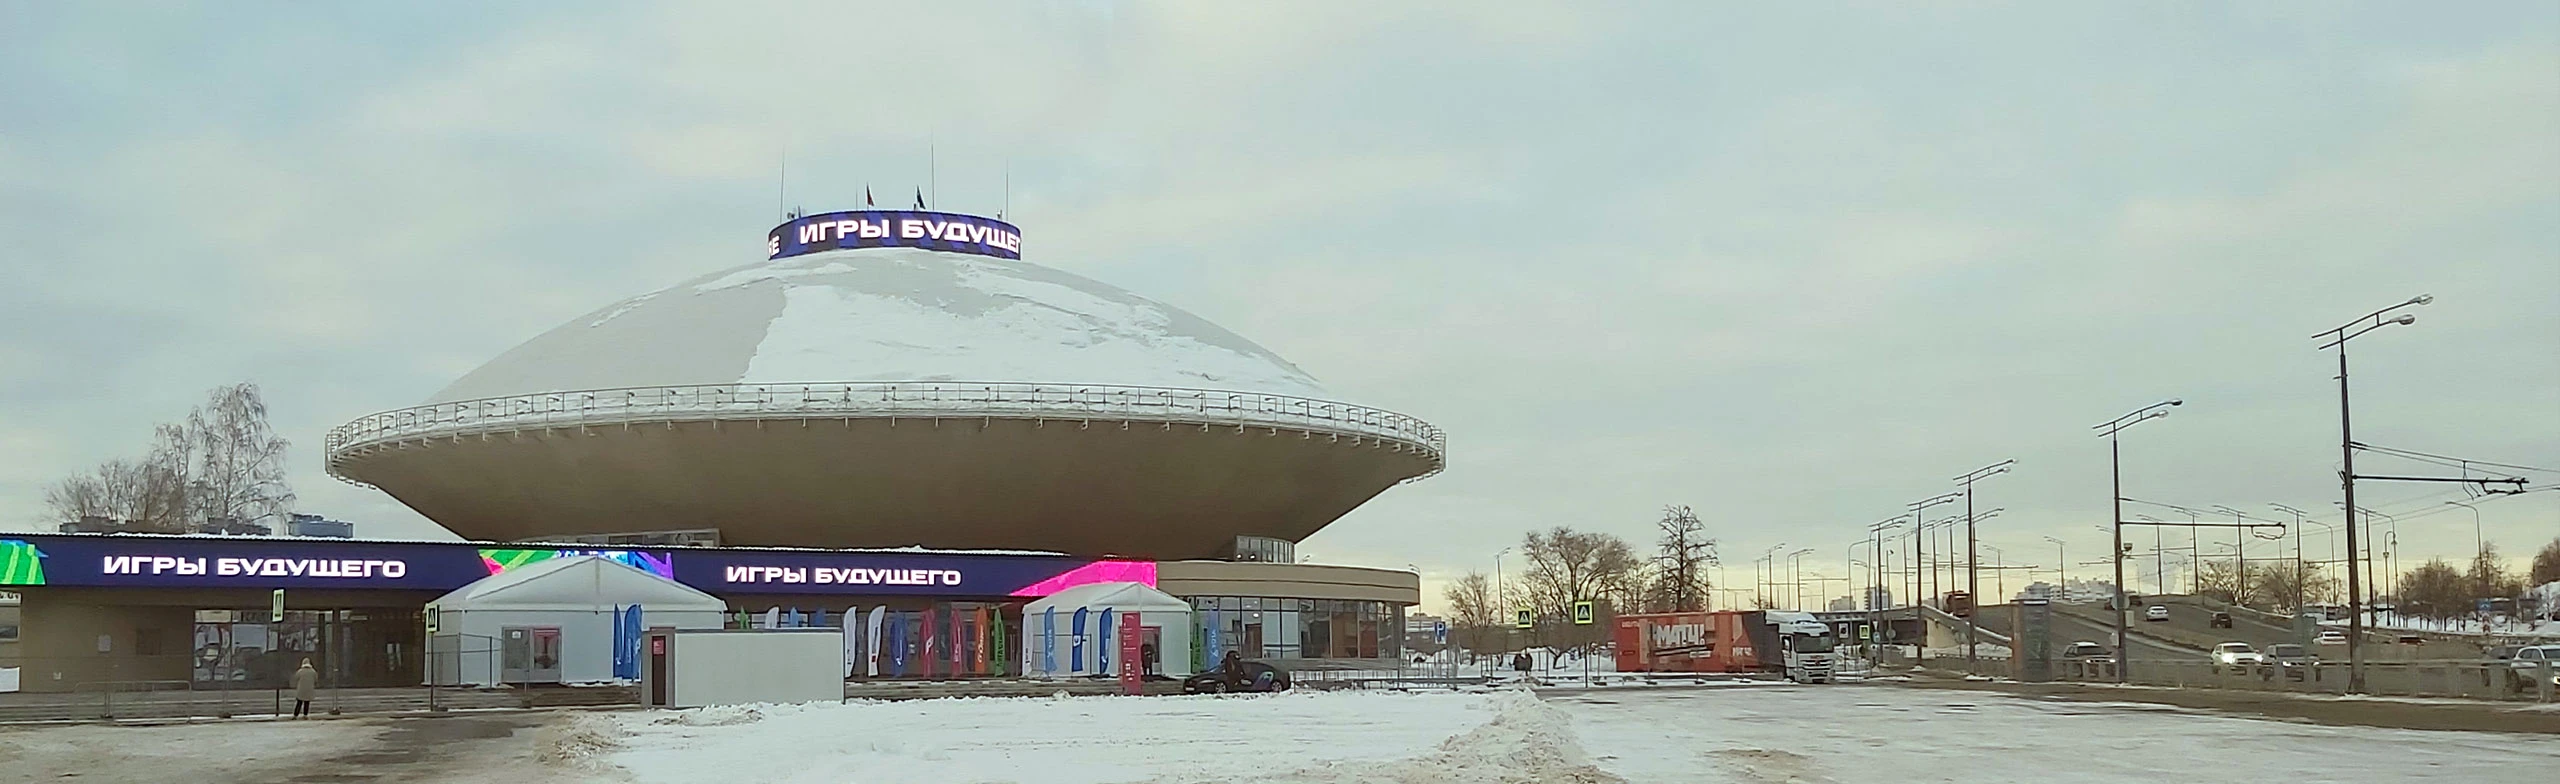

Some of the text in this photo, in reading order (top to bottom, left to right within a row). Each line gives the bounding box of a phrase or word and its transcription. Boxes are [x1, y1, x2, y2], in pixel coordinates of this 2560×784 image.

[800, 218, 890, 245] ИГРЫ
[103, 556, 406, 578] ИГРЫ БУДУЩЕГО
[727, 566, 961, 585] ИГРЫ БУДУЩЕГО
